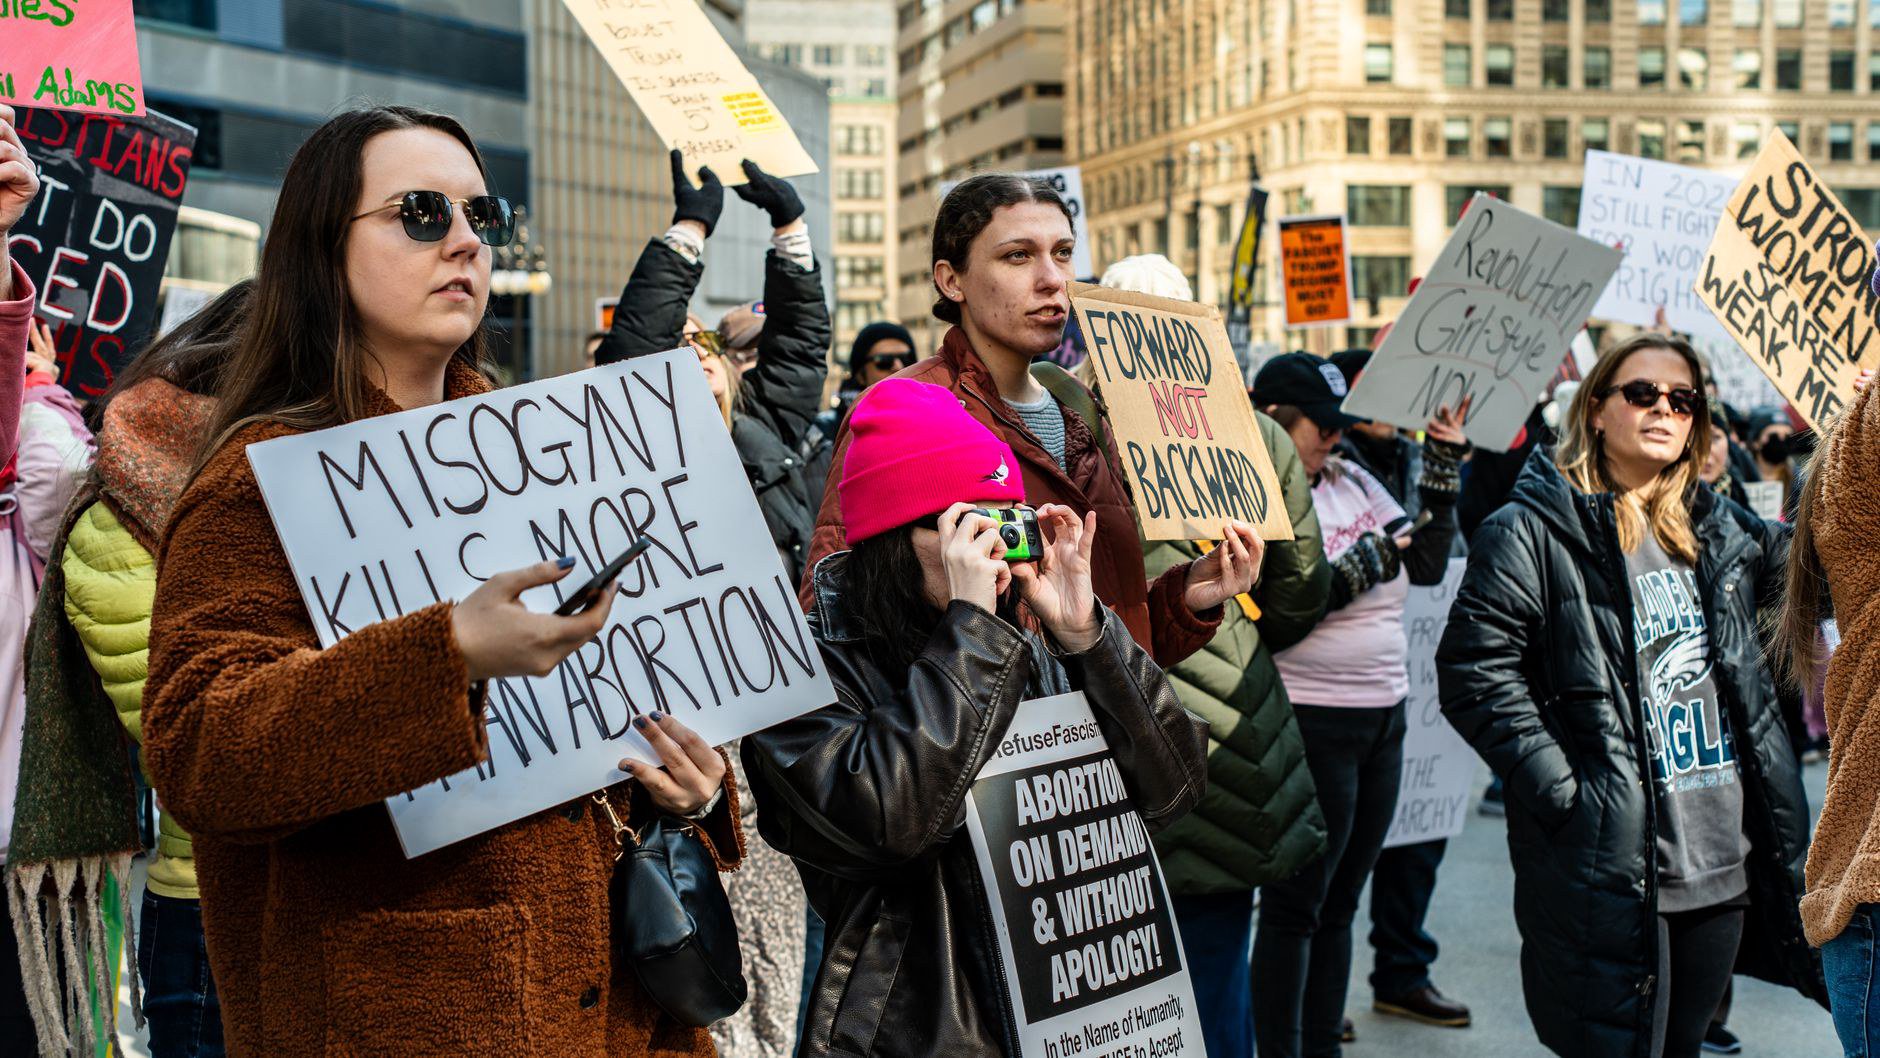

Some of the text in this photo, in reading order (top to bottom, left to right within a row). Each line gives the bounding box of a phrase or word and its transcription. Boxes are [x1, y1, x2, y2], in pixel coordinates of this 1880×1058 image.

[1591, 194, 1652, 229] STILL
[1600, 157, 1736, 214] IN 202
[89, 198, 157, 262] DO
[1454, 208, 1593, 336] Revolution
[1737, 184, 1873, 365] WOMEN
[1085, 310, 1212, 386] FORWARD
[1703, 255, 1789, 378] WEAK
[1744, 261, 1846, 387] SCARE
[1148, 380, 1213, 440] NOT
[1408, 364, 1495, 427] NOW
[318, 361, 687, 539] MISOGYNY
[1126, 440, 1268, 525] BACKWARD
[528, 473, 724, 604] MORE
[559, 574, 816, 750] ABORTION
[1015, 757, 1128, 826] ABORTION
[1403, 754, 1442, 790] THE
[1010, 811, 1147, 887] ON DEMAND
[1032, 865, 1155, 945] & WITHOUT
[1051, 924, 1163, 1003] APOLOGY!
[1061, 1031, 1081, 1055] the
[1083, 1021, 1120, 1050] Name
[1122, 1010, 1134, 1036] of
[1135, 994, 1184, 1031] Humanity,
[1149, 1027, 1184, 1058] Accept
